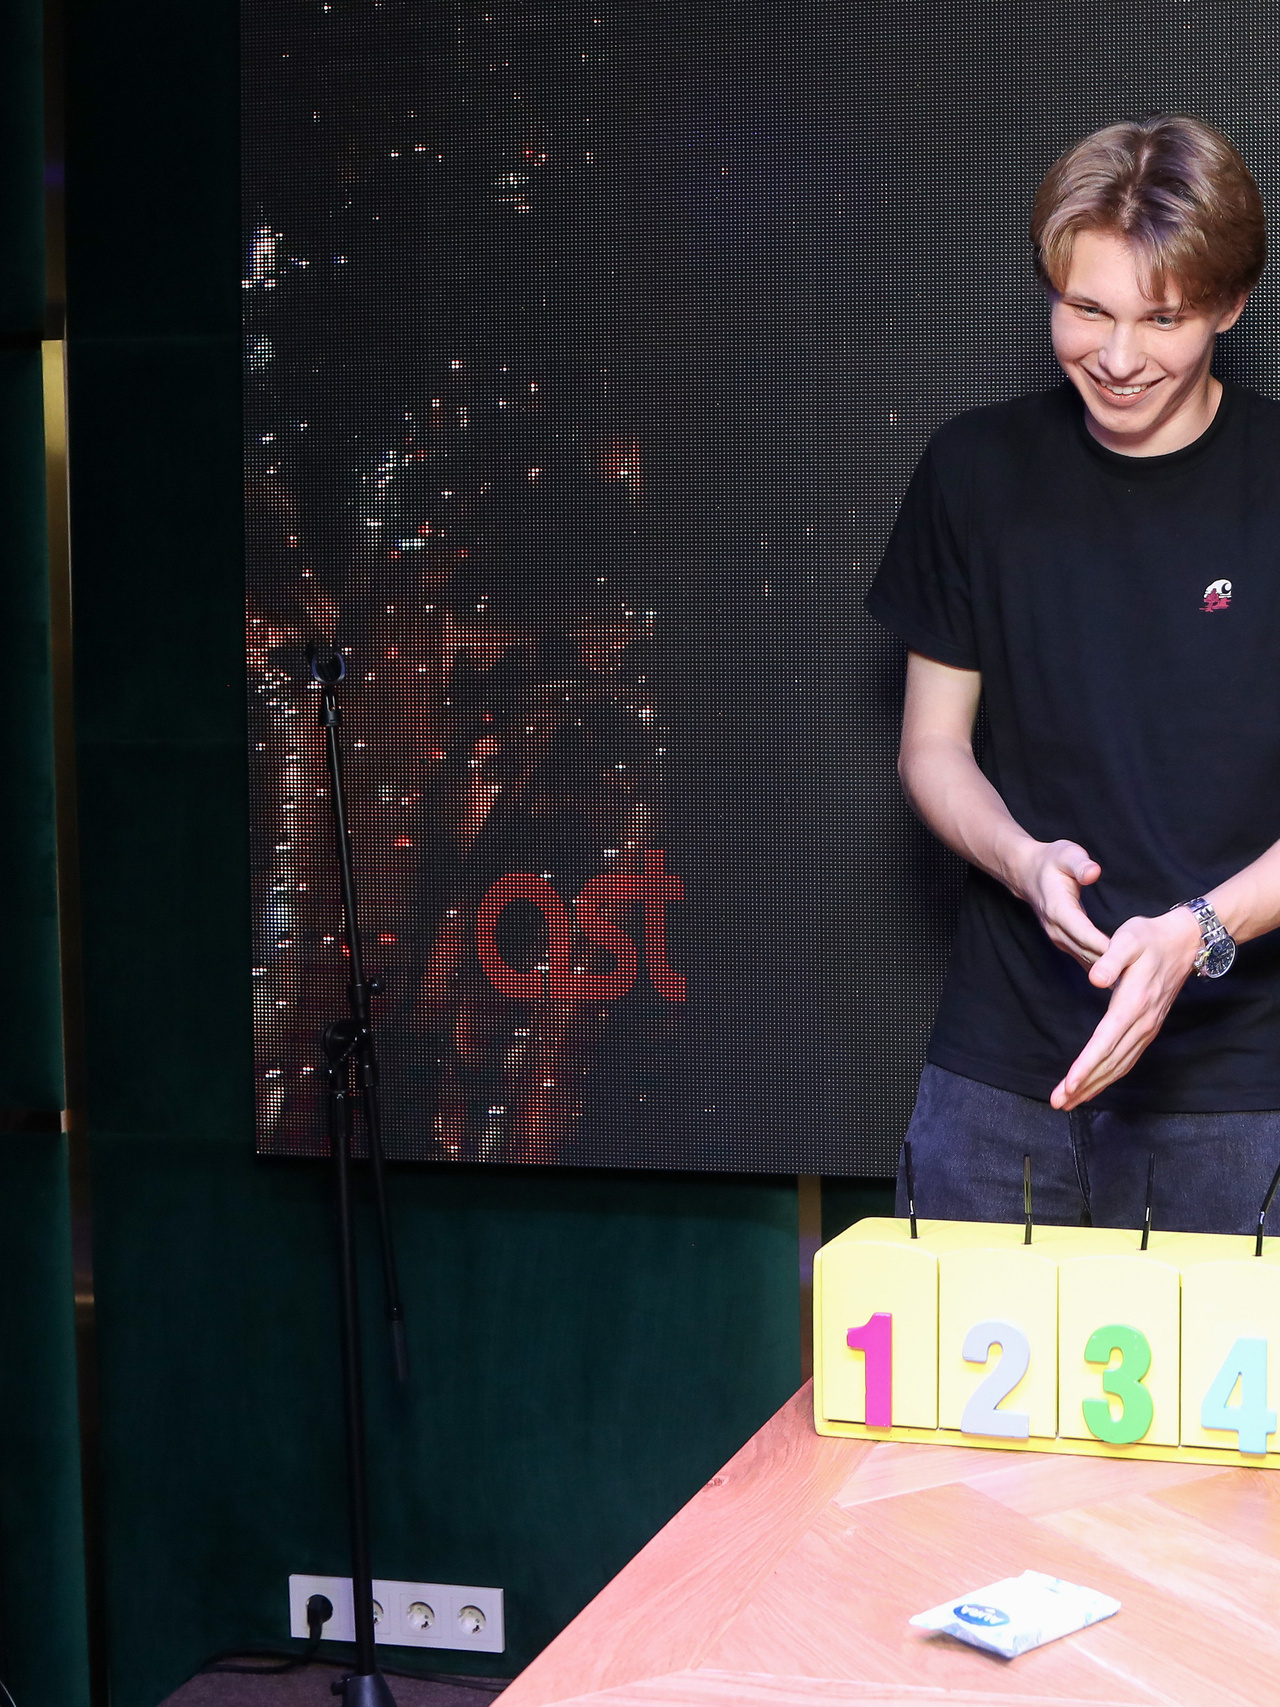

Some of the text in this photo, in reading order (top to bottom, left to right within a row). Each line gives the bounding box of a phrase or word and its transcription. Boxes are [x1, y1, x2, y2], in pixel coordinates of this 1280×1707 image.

[847, 1312, 892, 1427] 1
[961, 1319, 1030, 1438] 2
[1082, 1323, 1153, 1444] 3
[1201, 1336, 1277, 1454] 4
